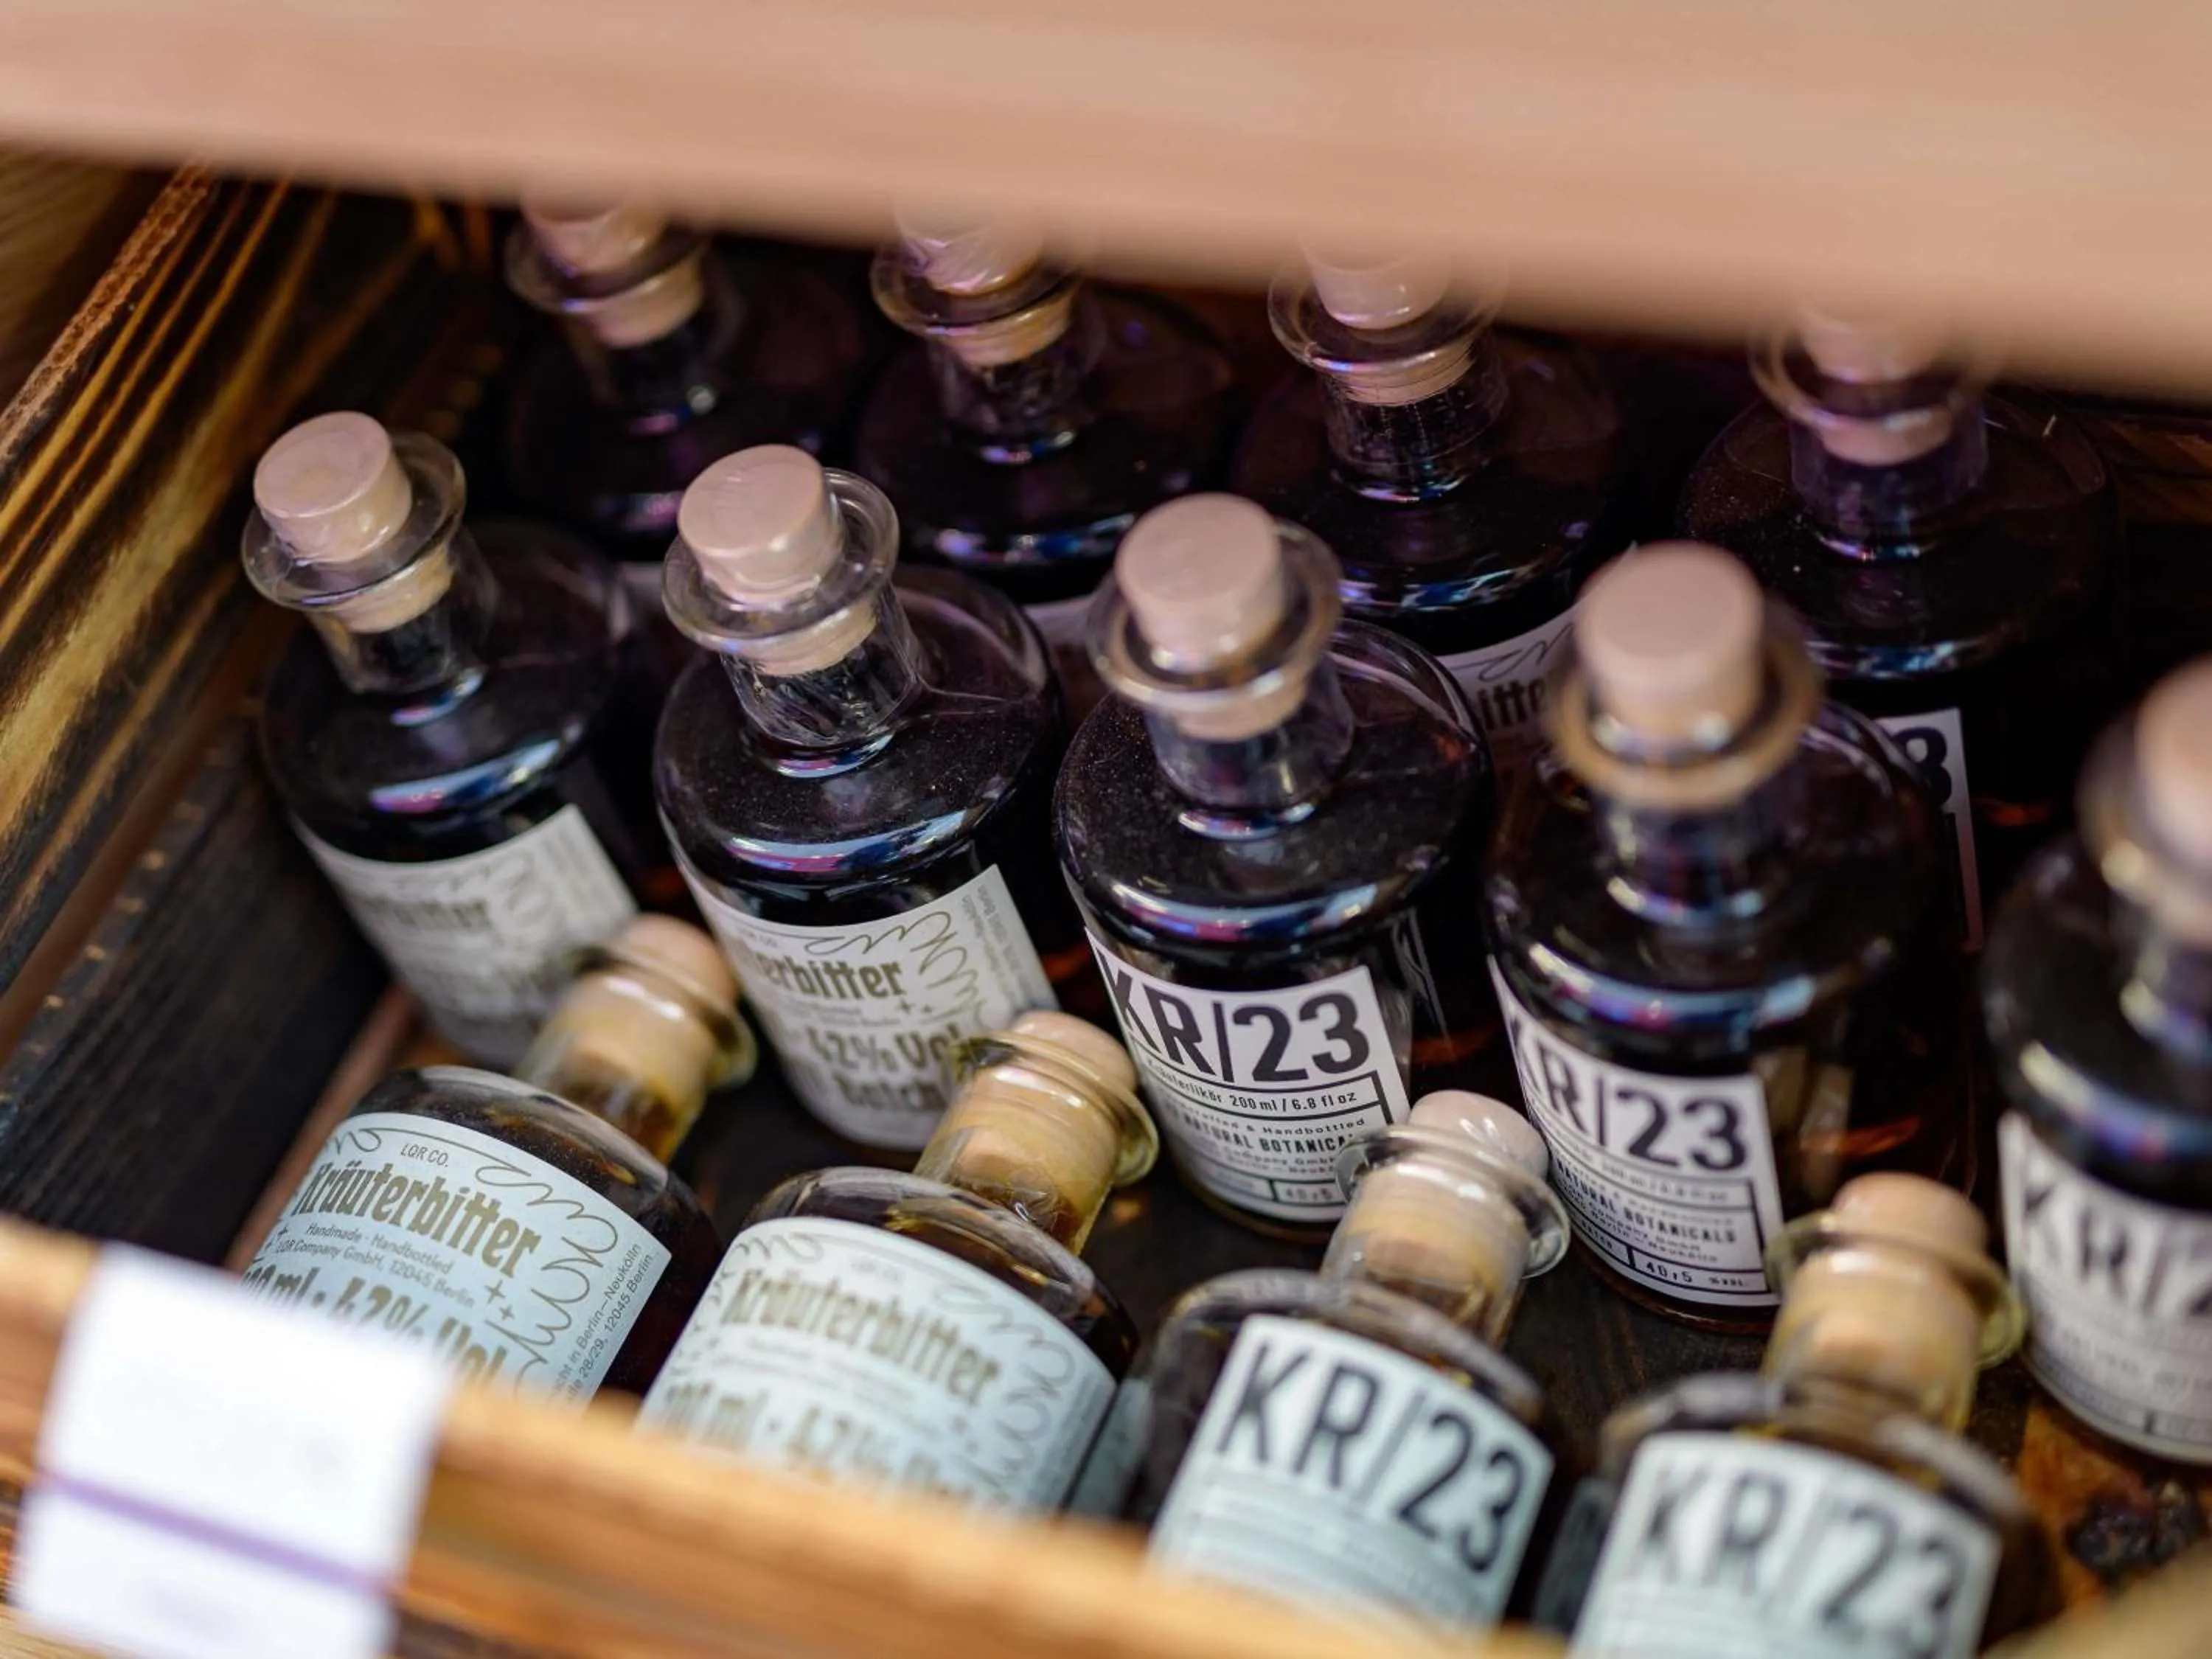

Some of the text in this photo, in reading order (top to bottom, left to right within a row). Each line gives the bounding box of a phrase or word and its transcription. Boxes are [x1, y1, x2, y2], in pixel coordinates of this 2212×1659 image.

[757, 952, 907, 1001] erbitter
[1096, 948, 1370, 1083] KR/23
[1228, 1094, 1255, 1110] 200
[1259, 1097, 1278, 1113] ml
[1292, 1096, 1317, 1111] 6.8
[1338, 1091, 1358, 1105] oz
[1262, 1118, 1366, 1136] Handbottled
[400, 1143, 450, 1168] LQR CO.
[1259, 1133, 1353, 1155] BOTANICA
[291, 1161, 542, 1279] Kräuterbitter
[305, 1222, 363, 1243] Handmade
[295, 1240, 342, 1259] Company
[343, 1245, 384, 1272] GmbH,
[389, 1259, 433, 1287] 12045
[432, 1277, 476, 1308] Berlin
[1644, 1262, 1694, 1284] 40,5
[604, 1293, 631, 1333] 12045
[626, 1253, 655, 1296] Berlin
[568, 1349, 582, 1365] in
[1215, 1342, 1524, 1574] KR/23
